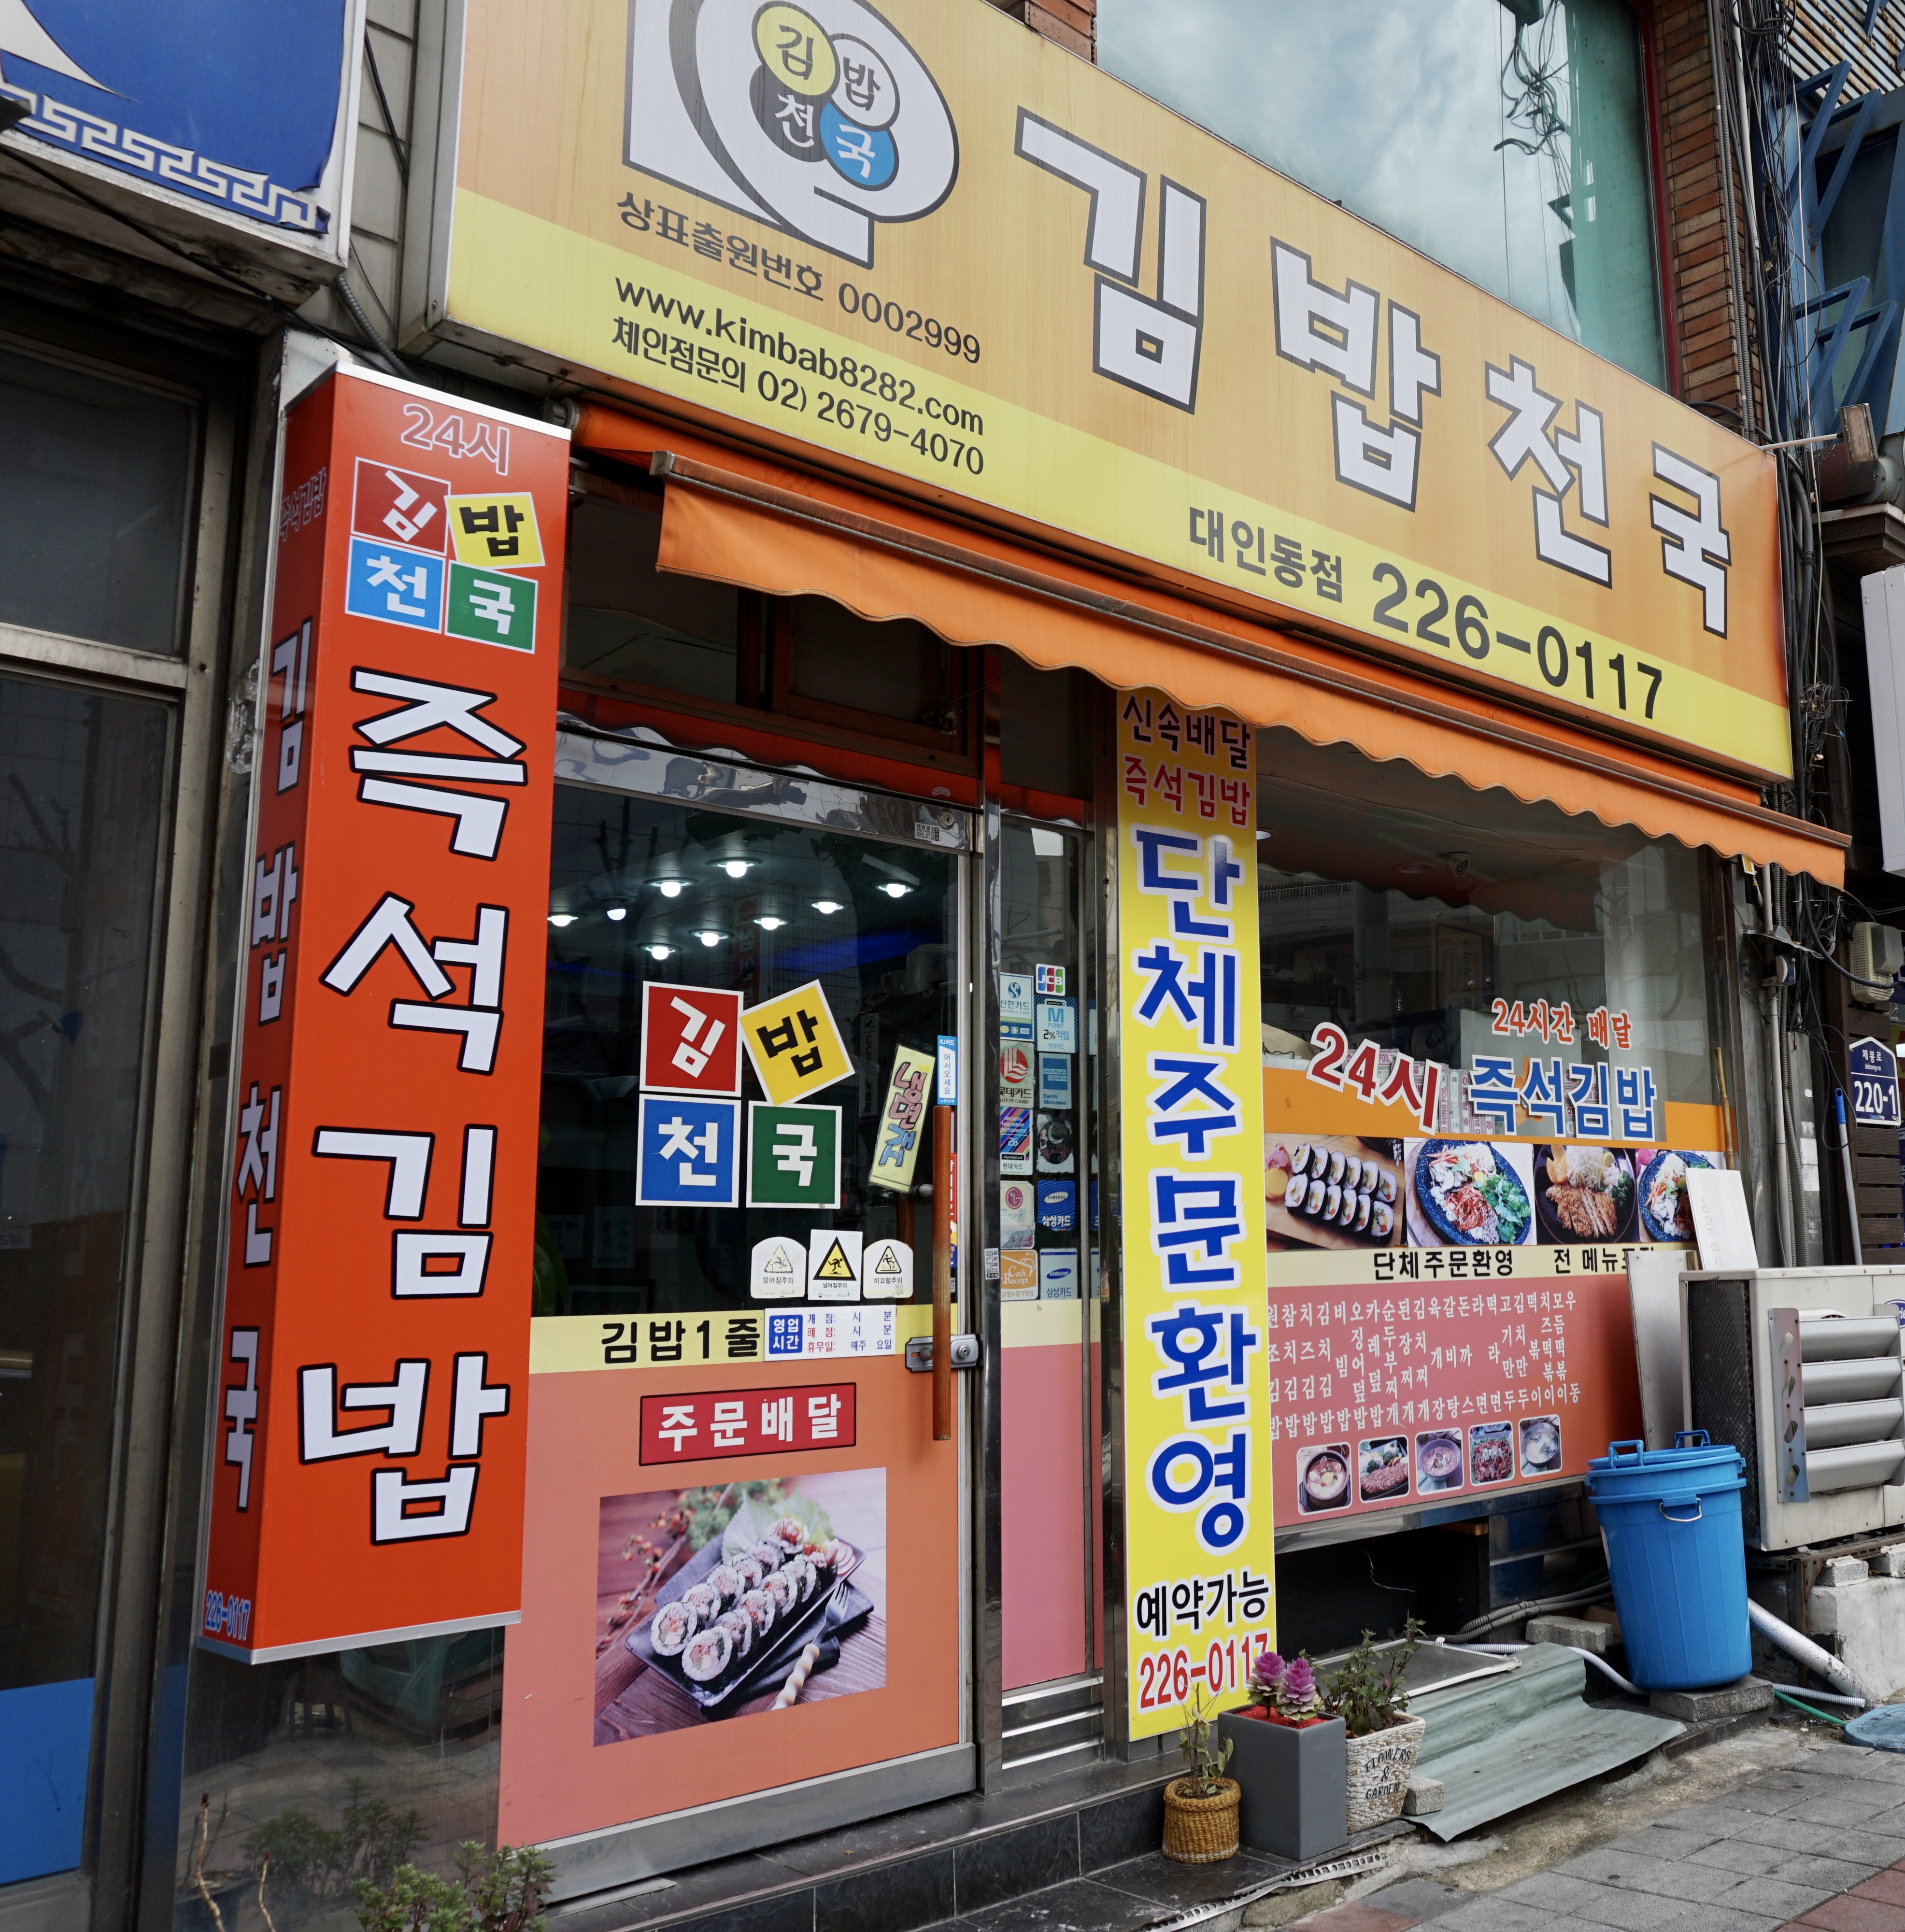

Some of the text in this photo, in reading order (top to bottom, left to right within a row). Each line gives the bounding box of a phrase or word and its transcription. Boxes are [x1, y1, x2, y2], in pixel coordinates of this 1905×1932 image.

[617, 192, 980, 363] 상표출원번호 0002999
[615, 277, 983, 435] www.kimbab8282.com
[612, 316, 983, 474] 체인점문의 02) 2679-4070
[401, 404, 510, 475] 24시
[1190, 507, 1663, 719] 대인동점 226-0117
[1123, 696, 1250, 768] 신속배달
[1123, 756, 1251, 826] 즉석김밥
[1038, 975, 1063, 985] JCB
[1000, 1000, 1030, 1010] 신한카드
[1048, 1008, 1064, 1023] M
[1493, 998, 1631, 1049] 24시간 배달
[1862, 1049, 1882, 1064] 제봉로
[1865, 1063, 1882, 1072] Jebong-ro
[1308, 1024, 1440, 1133] 24시
[1469, 1056, 1656, 1139] 즉석김밥
[1854, 1080, 1897, 1115] 220-1
[1041, 1215, 1071, 1227] 삼성카드
[1003, 1273, 1029, 1285] Receipt
[1008, 1265, 1025, 1279] Cash
[1374, 1250, 1513, 1280] 단체주문환영
[1554, 1248, 1571, 1274] 전
[1047, 1287, 1072, 1298] 삼성카드
[773, 1318, 799, 1334] 영업
[772, 1335, 799, 1350] 시간
[876, 1339, 892, 1350] 요일
[658, 1393, 841, 1452] 주문배달
[205, 1589, 251, 1641] 226-0117
[1137, 1572, 1269, 1636] 예약가능
[1365, 1747, 1412, 1772] FLOWERS
[1366, 1782, 1400, 1800] GARDEN
